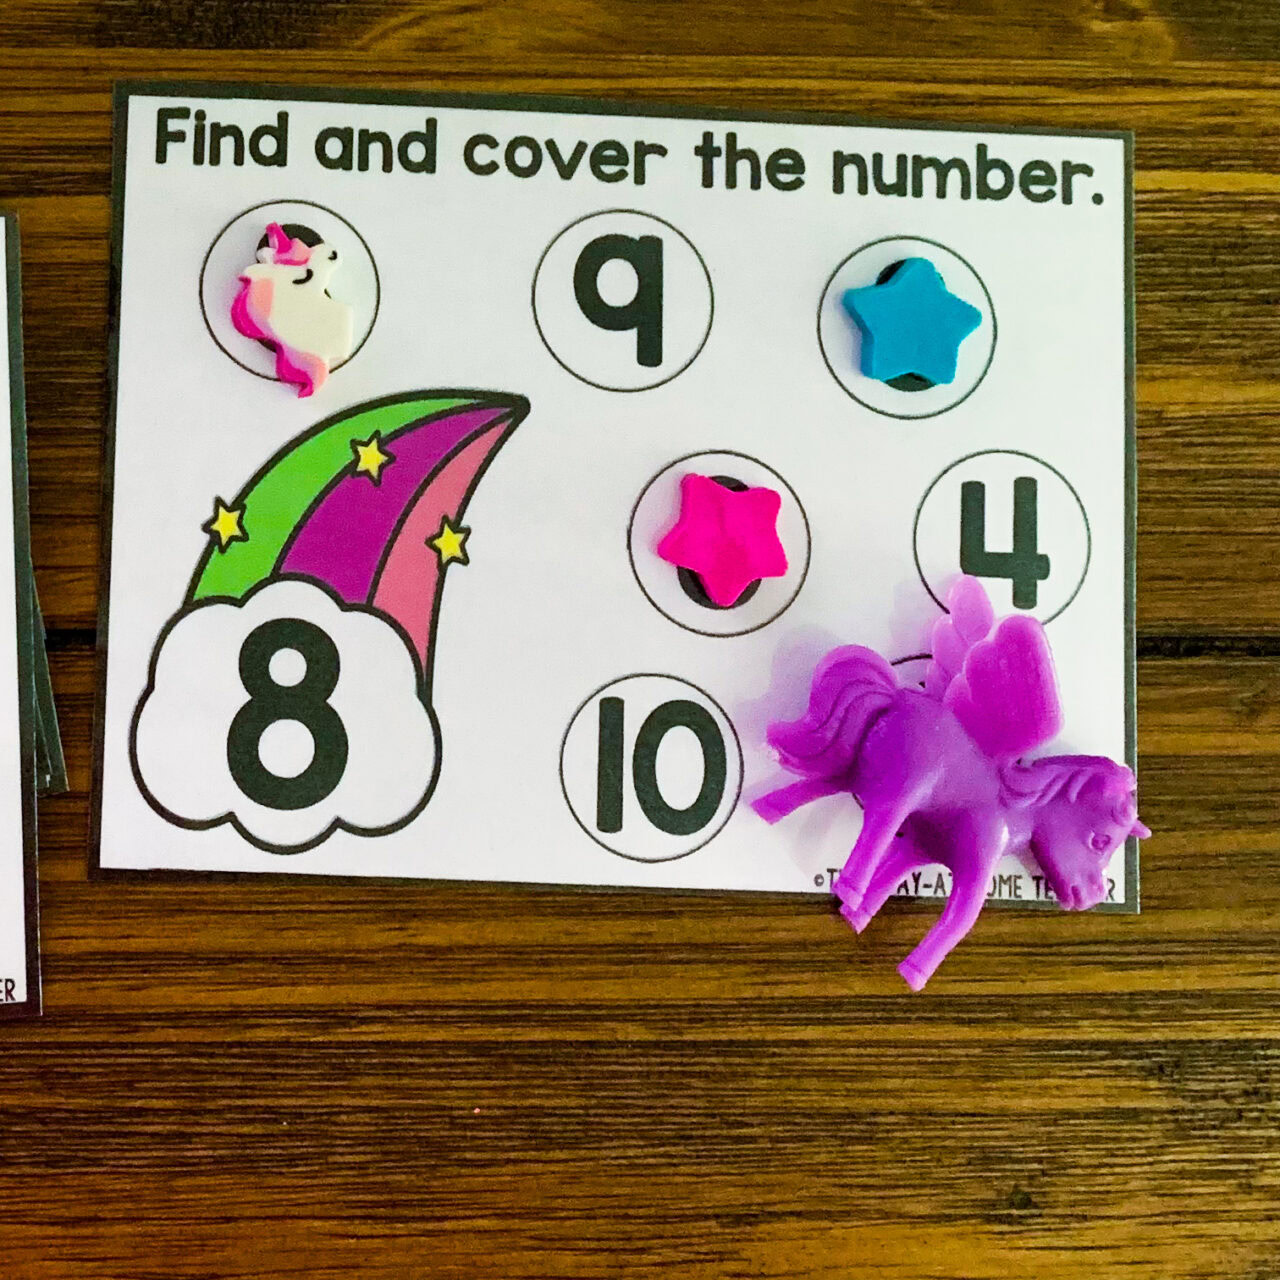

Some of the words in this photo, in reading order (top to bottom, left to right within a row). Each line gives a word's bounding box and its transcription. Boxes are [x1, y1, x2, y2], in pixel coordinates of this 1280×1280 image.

[155, 106, 290, 168] Find
[314, 117, 438, 175] and
[463, 133, 668, 186] cover
[694, 131, 806, 192] the
[832, 143, 1105, 207] number.
[960, 476, 1051, 610] 4
[227, 618, 349, 811] 8
[596, 696, 727, 837] 10
